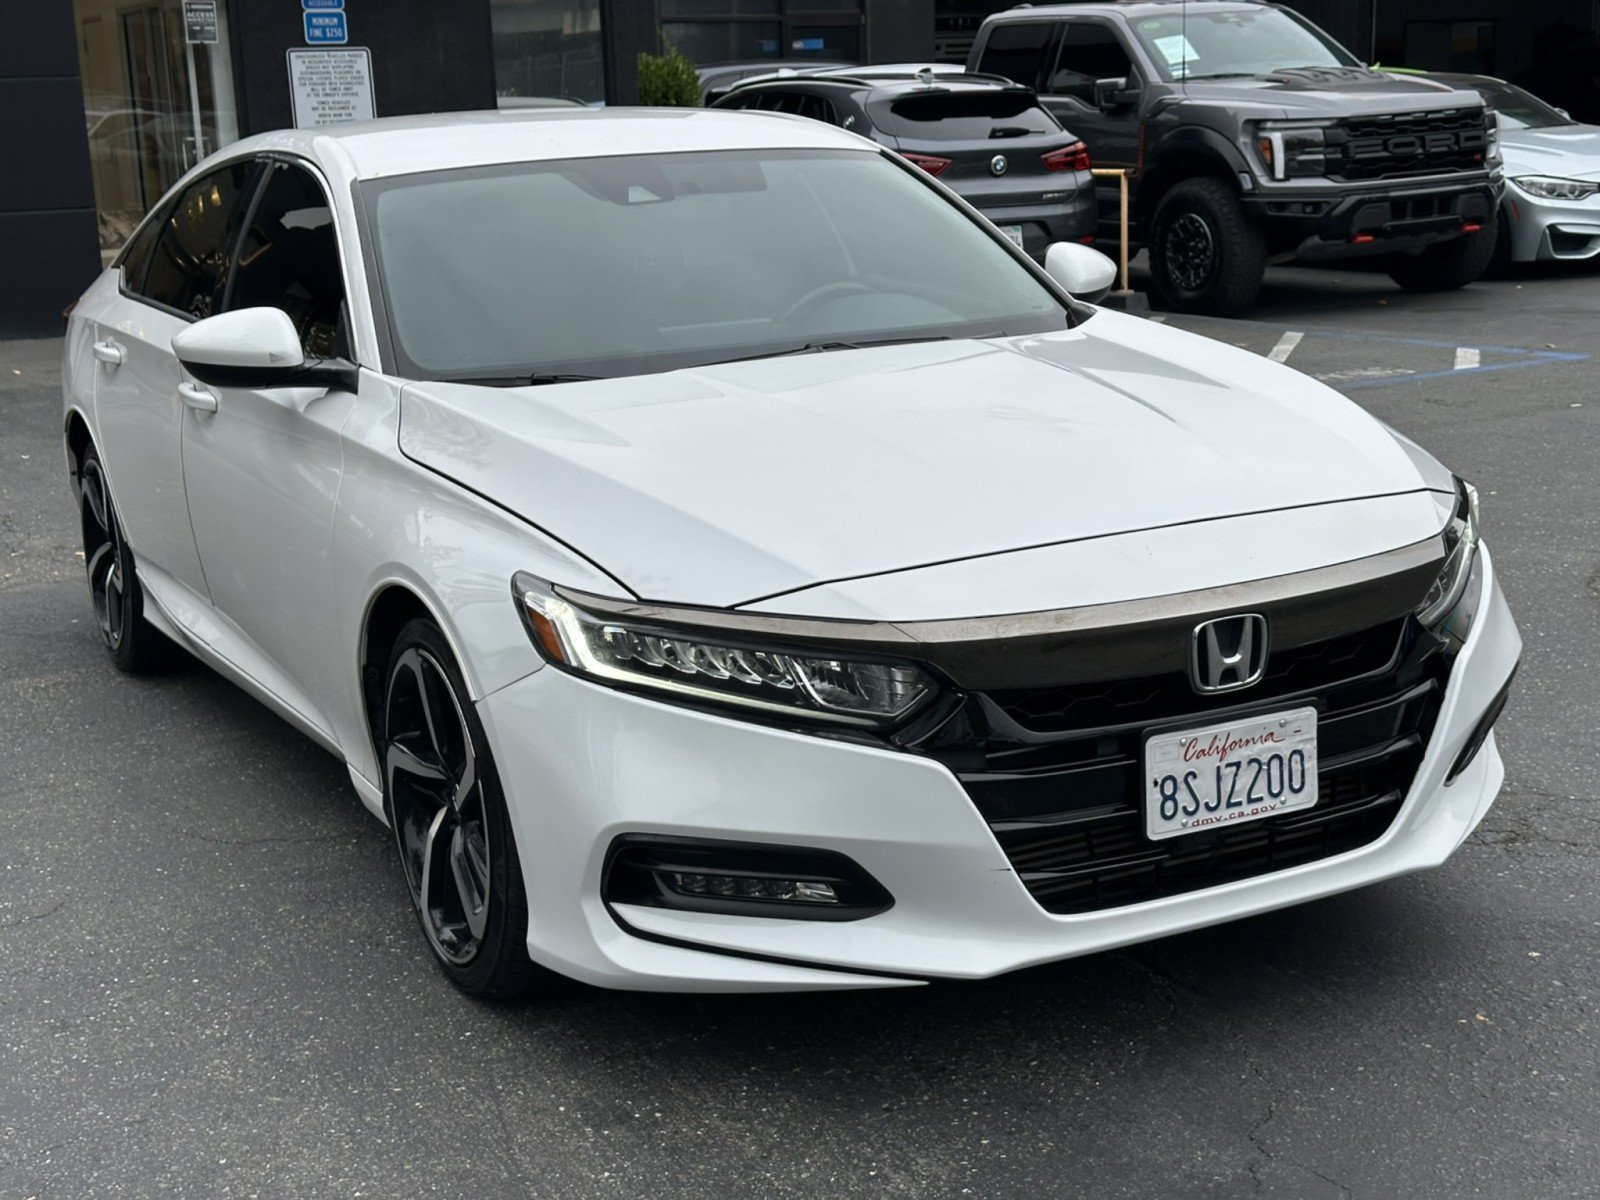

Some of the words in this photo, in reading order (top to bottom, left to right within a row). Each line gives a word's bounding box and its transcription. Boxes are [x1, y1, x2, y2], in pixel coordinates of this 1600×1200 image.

[310, 28, 324, 38] FINE
[326, 27, 343, 38] $250
[312, 16, 338, 26] MINIMUM
[1347, 130, 1486, 158] FORD
[1183, 728, 1285, 762] California
[1159, 749, 1306, 821] 8SJZ200
[1191, 803, 1277, 827] dmv.ca.gov
